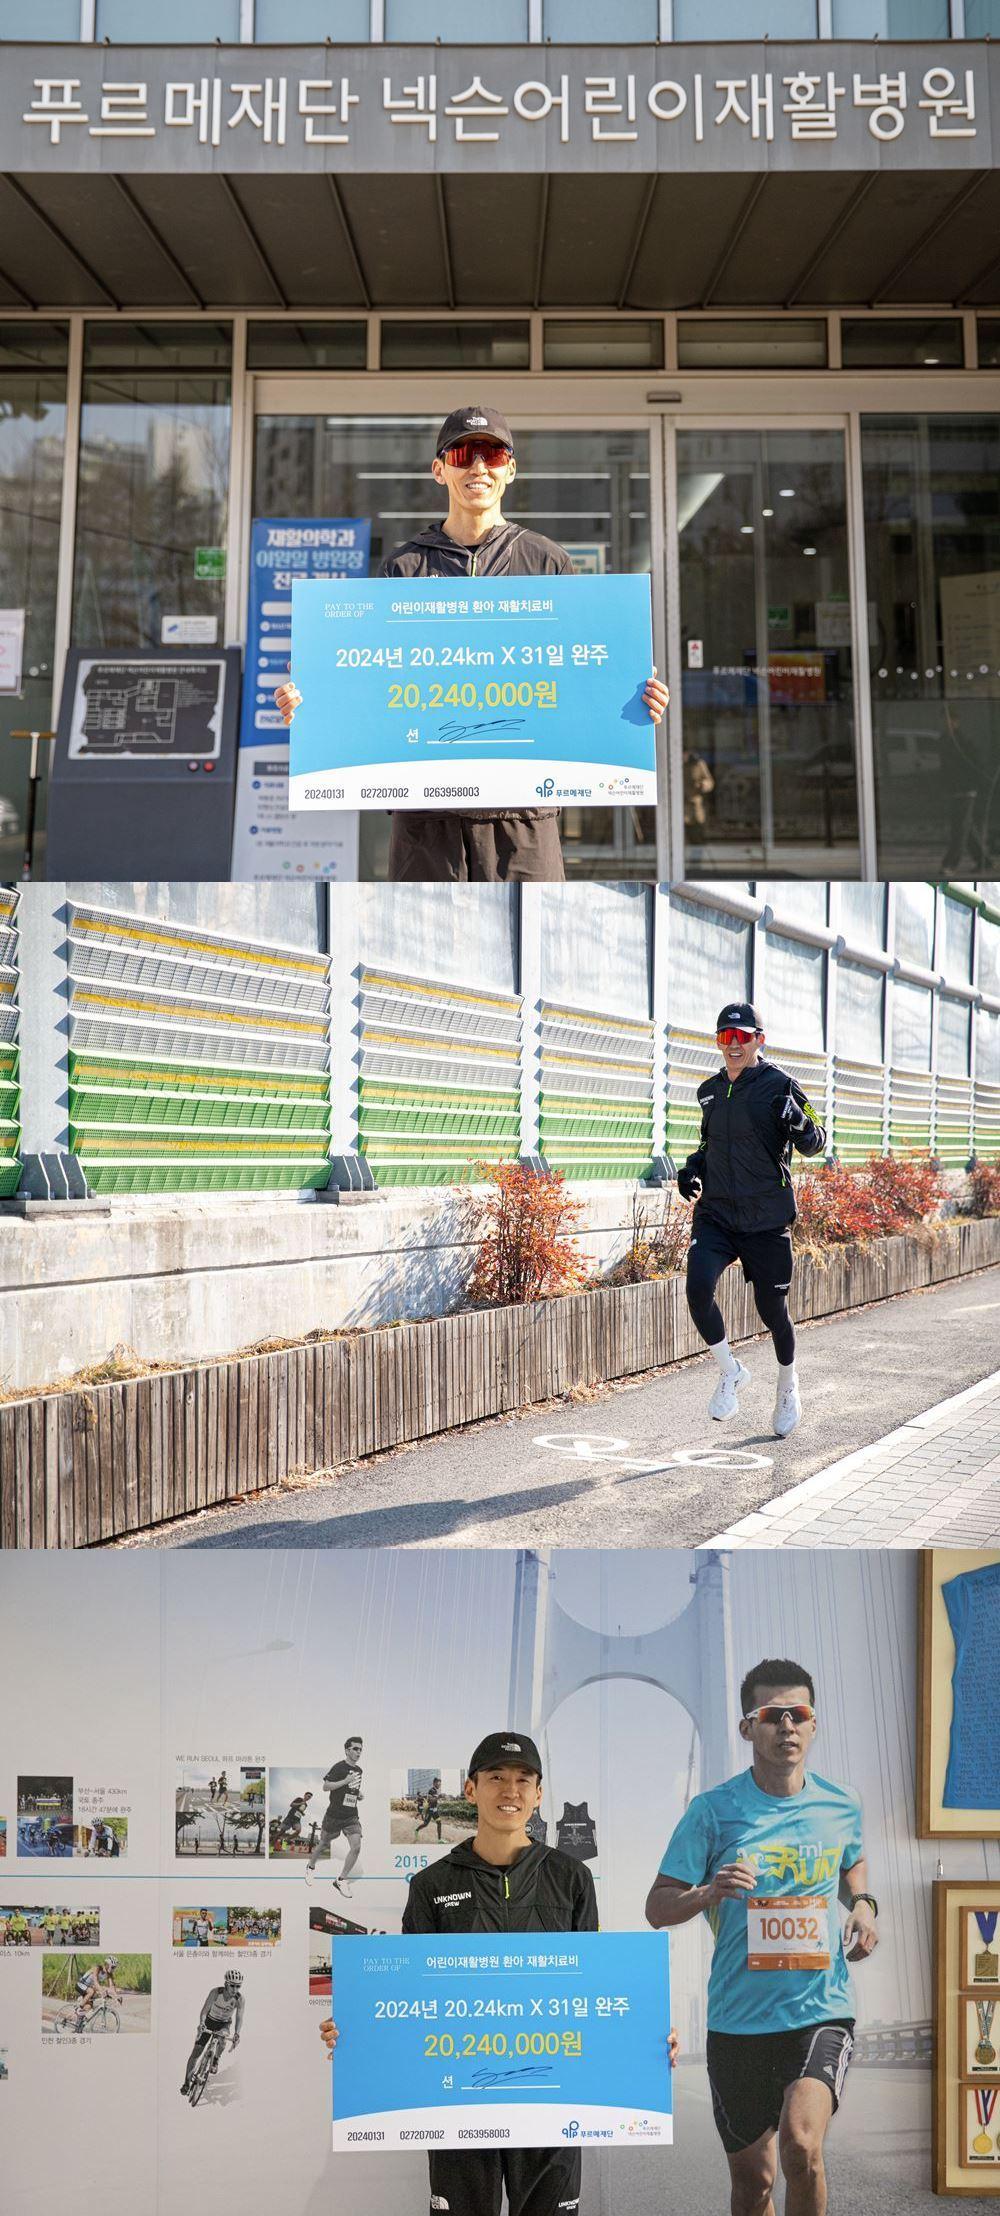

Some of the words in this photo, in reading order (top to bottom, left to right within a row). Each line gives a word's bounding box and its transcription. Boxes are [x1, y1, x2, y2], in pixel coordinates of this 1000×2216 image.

[22, 74, 360, 146] 푸르메재단
[381, 66, 978, 143] 넥슨어린이재활병원
[267, 529, 356, 548] 재활의학과
[312, 550, 364, 570] 병원장
[325, 603, 341, 611] PAY
[344, 603, 355, 611] TO
[357, 602, 374, 610] THE
[391, 600, 468, 615] 어린이재활병원
[473, 600, 495, 613] 환아
[498, 599, 554, 613] 재활치료비
[325, 611, 350, 619] ORDER
[335, 648, 403, 669] 2024년
[410, 646, 495, 666] 20.24km
[501, 647, 516, 665] X
[521, 645, 565, 666] 31일
[571, 644, 609, 666] 완주
[387, 680, 558, 711] 20,240,000원
[406, 728, 419, 743] 션
[304, 789, 345, 800] 20240131
[360, 787, 410, 799] 027207002
[423, 786, 480, 798] 0263958003
[556, 789, 592, 797] 푸르메재단
[395, 1855, 428, 1868] 2015
[433, 1891, 472, 1905] UNKNOWN
[760, 1917, 819, 1941] 10032
[426, 1956, 499, 1969] 어린이재활병원
[503, 1956, 524, 1968] 환아
[527, 1955, 579, 1968] 재활치료비
[375, 1999, 438, 2020] 2024년
[444, 1998, 524, 2018] 20.24km
[530, 1999, 544, 2016] X
[548, 1998, 588, 2017] 31일
[595, 1997, 630, 2017] 완주
[424, 2032, 582, 2059] 20,240,000원
[442, 2076, 453, 2089] 션
[347, 2131, 385, 2142] 20240131
[399, 2130, 445, 2141] 027207002
[458, 2129, 511, 2139] 0263958003
